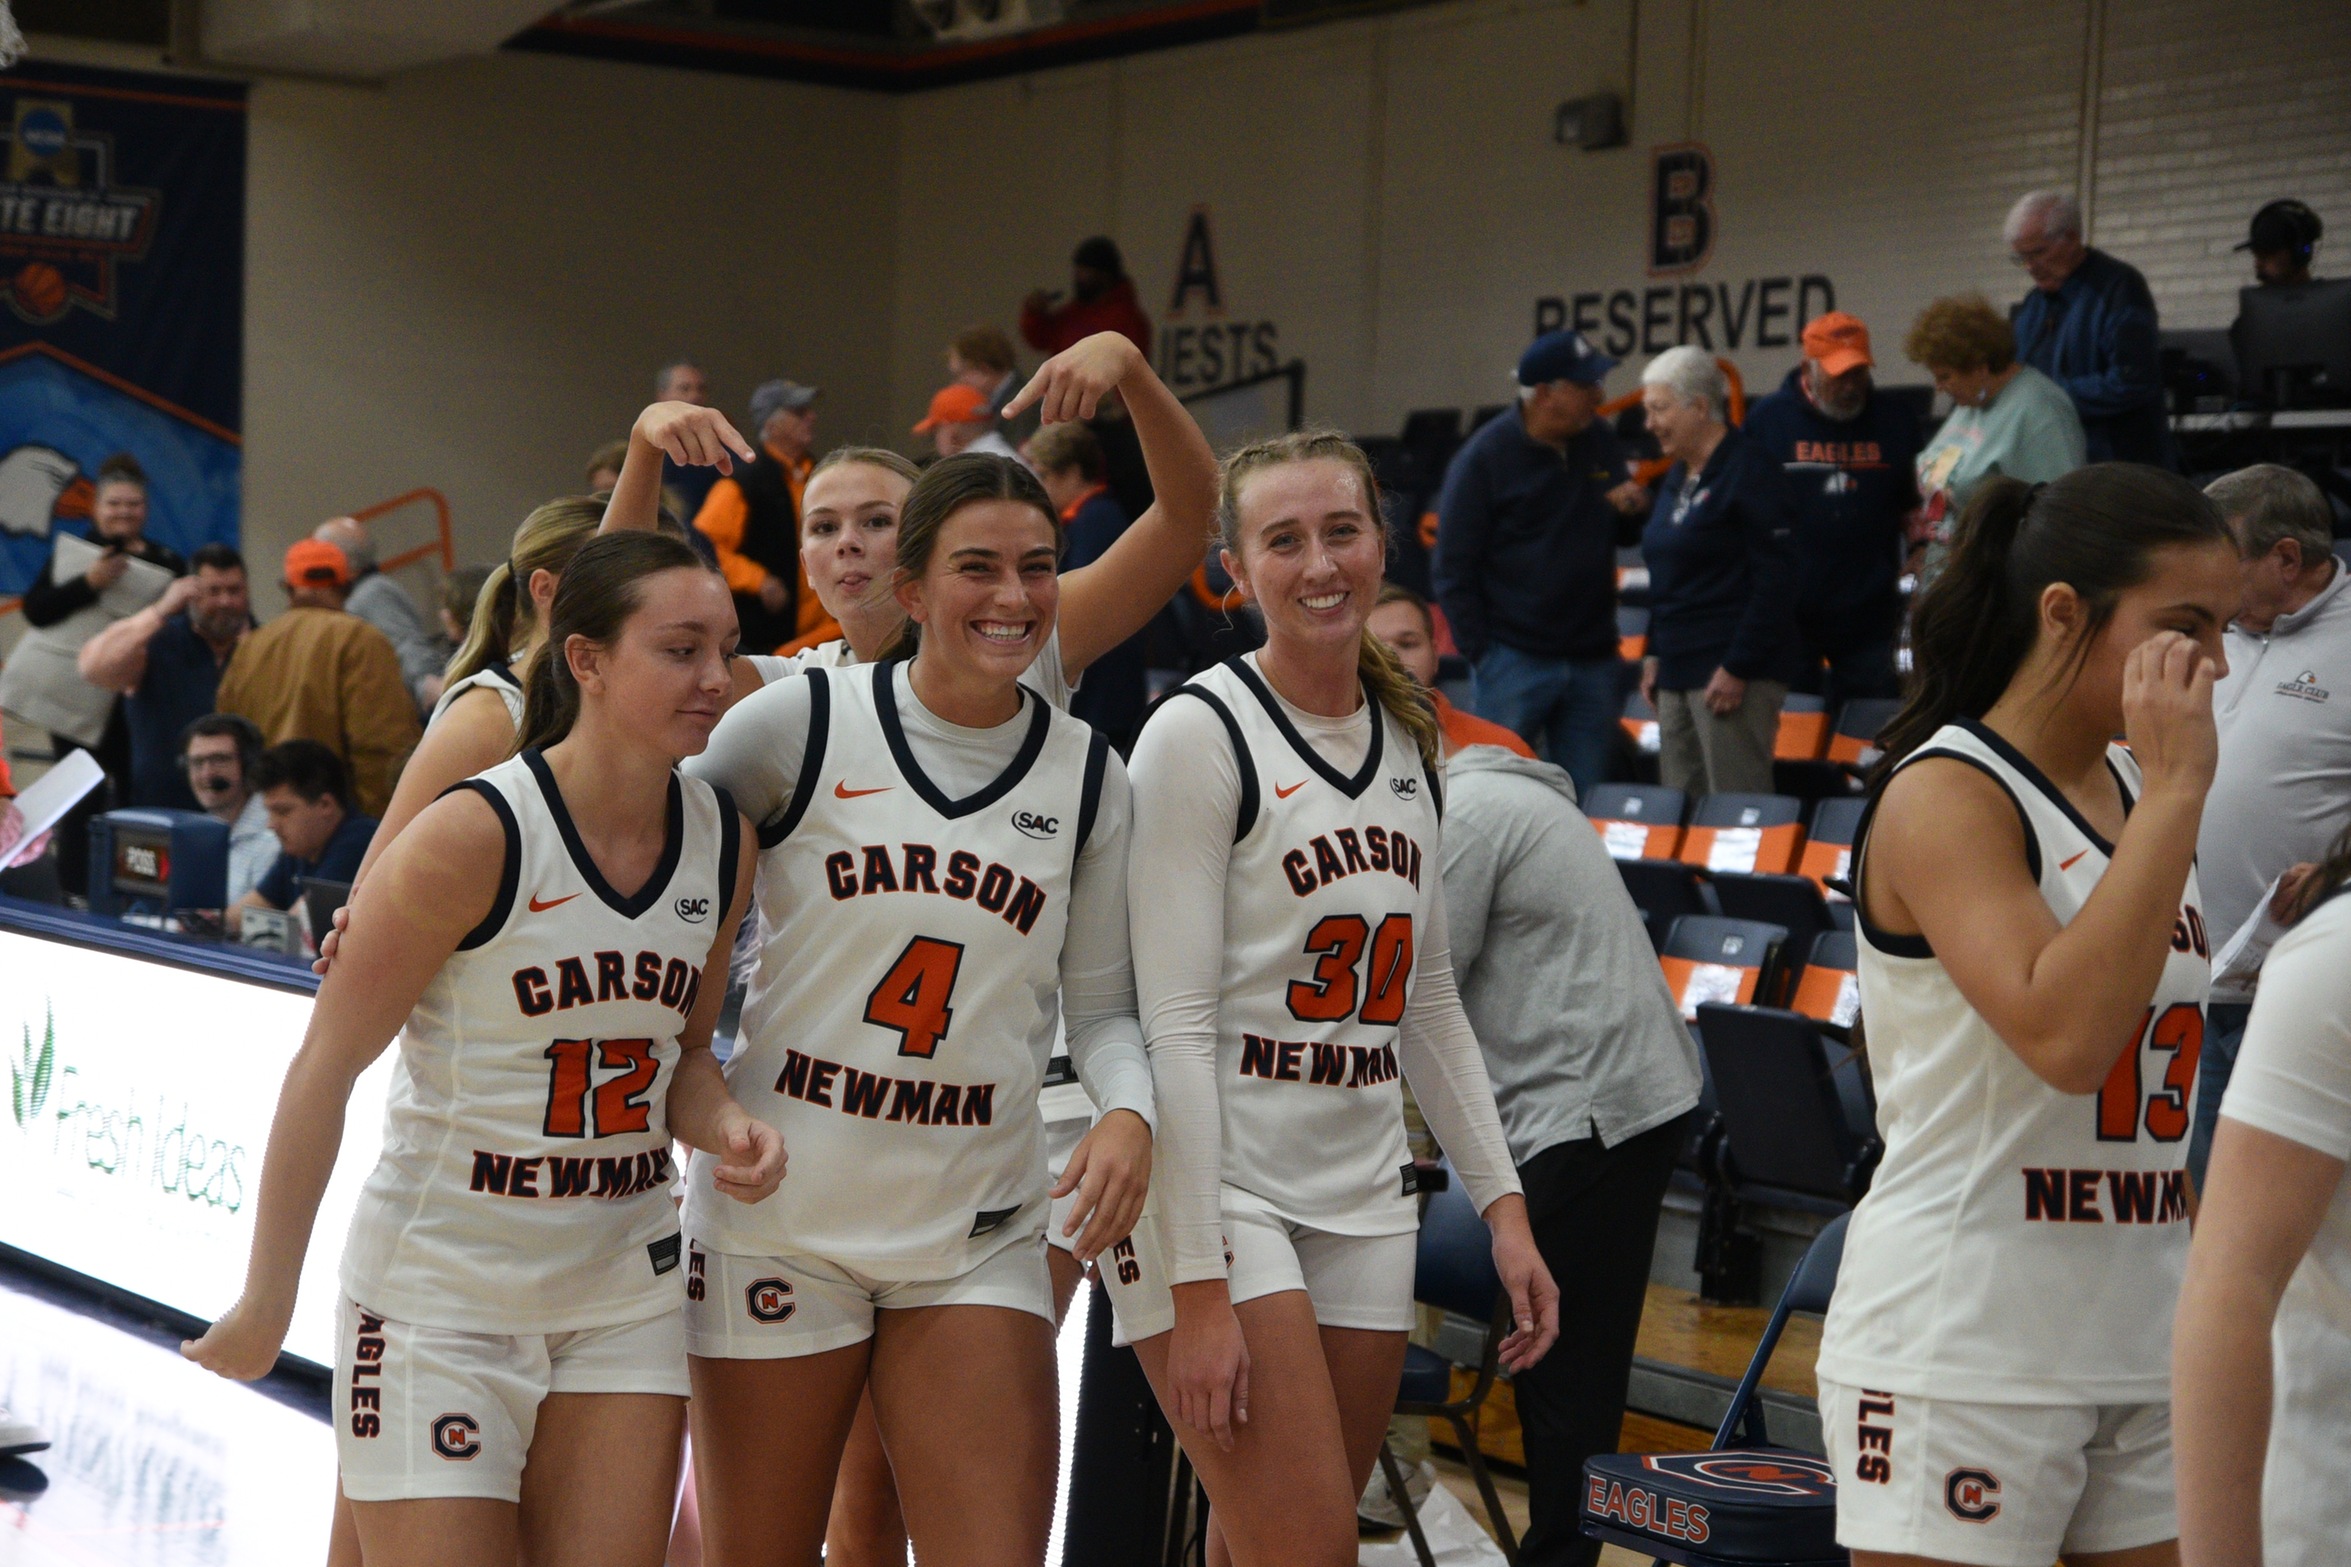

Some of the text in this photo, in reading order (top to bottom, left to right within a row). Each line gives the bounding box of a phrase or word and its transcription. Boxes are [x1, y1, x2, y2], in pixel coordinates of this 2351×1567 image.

[1647, 143, 1717, 278] B
[1163, 203, 1229, 321] A
[1159, 319, 1278, 386] ESTS
[1535, 275, 1838, 357] RESERVED
[1795, 440, 1882, 462] EAGLES
[1392, 777, 1417, 795] SAC
[1017, 811, 1060, 836] SAC
[824, 842, 1047, 937] CARSON
[1281, 825, 1423, 898] CARSON
[679, 898, 709, 916] SAC
[511, 950, 702, 1019] CARSON
[862, 934, 966, 1060] 4
[1285, 912, 1414, 1027] 30
[542, 1037, 661, 1139] 12
[773, 1047, 996, 1127] NEWMAN
[1239, 1033, 1399, 1089] NEWMAN
[2096, 1002, 2205, 1143] 13
[469, 1146, 670, 1200] NEWMAN
[2021, 1167, 2189, 1225] NEWM
[351, 1302, 386, 1438] AGLES
[1587, 1473, 1711, 1544] EAGLES
